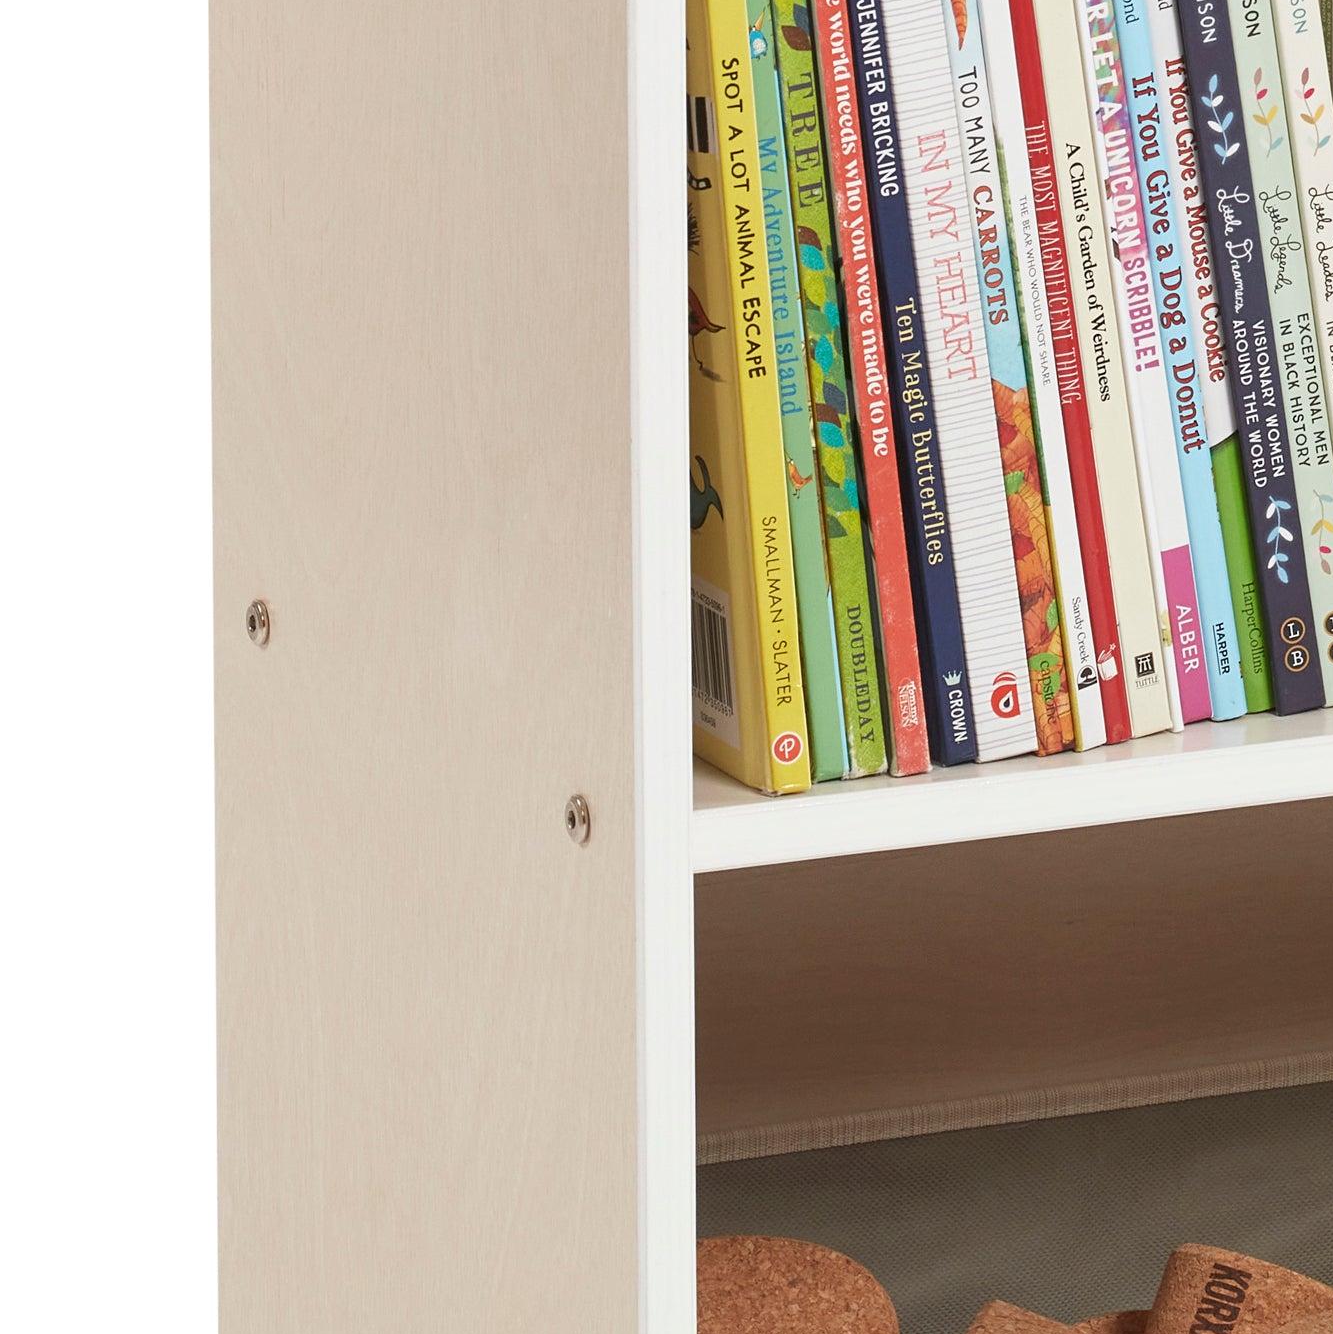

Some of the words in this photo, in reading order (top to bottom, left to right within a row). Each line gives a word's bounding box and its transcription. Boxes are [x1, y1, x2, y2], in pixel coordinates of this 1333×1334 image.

[829, 11, 851, 81] world
[857, 0, 887, 95] JENNIFER
[1089, 32, 1119, 87] LET
[1165, 57, 1186, 77] If
[722, 57, 743, 113] SPOT
[958, 66, 979, 109] TOO
[1100, 101, 1122, 121] A
[1132, 72, 1155, 99] If
[1168, 81, 1191, 126] You
[728, 126, 743, 141] A
[787, 71, 824, 209] TREE
[836, 86, 857, 155] needs
[870, 101, 899, 196] BRICKING
[964, 116, 991, 174] MANY
[1025, 121, 1048, 155] THE
[1137, 103, 1160, 161] You
[729, 150, 750, 192] LOT
[758, 136, 777, 173] My
[917, 129, 950, 173] IN
[1065, 142, 1081, 159] A
[1176, 128, 1198, 181] Give
[845, 159, 862, 219] who
[924, 180, 959, 241] MY
[1019, 195, 1029, 216] THE
[1031, 164, 1054, 211] MOST
[1105, 129, 1141, 249] UNICORN
[1146, 170, 1171, 235] Give
[1184, 186, 1199, 201] a
[1216, 185, 1250, 236] Little
[763, 187, 790, 321] Adventure
[843, 216, 867, 261] you
[973, 185, 1010, 326] CARROTS
[1022, 219, 1032, 247] BEAR
[1077, 225, 1096, 291] Garden
[1156, 244, 1174, 262] a
[1186, 202, 1211, 280] Mouse
[1026, 249, 1037, 277] WHO
[1038, 220, 1074, 340] MAGNIFICENT
[1226, 239, 1253, 314] Dreamers
[855, 269, 873, 325] were
[895, 297, 917, 342] Ten
[933, 251, 978, 381] HEART
[1031, 280, 1043, 320] WOULD
[1087, 294, 1103, 312] of
[1124, 257, 1160, 372] SCRIBBLE!
[1159, 266, 1187, 330] Dog
[1197, 285, 1213, 300] a
[743, 297, 766, 378] ESCAPE
[862, 329, 882, 397] made
[1036, 323, 1046, 348] NOT
[1090, 314, 1111, 403] Weirdness
[1169, 337, 1187, 356] a
[1200, 302, 1229, 383] Cookie
[1233, 320, 1252, 386] AROUND
[775, 331, 803, 417] Island
[901, 350, 928, 424] Magic
[1039, 352, 1050, 386] SHARE
[1055, 347, 1082, 405] THING
[868, 401, 885, 424] to
[1172, 359, 1204, 454] Donut
[1243, 392, 1258, 426] THE
[1252, 319, 1276, 408] VISIONARY
[1265, 414, 1286, 478] WOMEN
[871, 429, 889, 458] be
[1249, 429, 1267, 488] WORLD
[911, 428, 945, 566] Butterflies
[762, 516, 784, 624] SMALLMAN
[773, 640, 792, 706] SLATER
[1072, 597, 1085, 630] Sandy
[1242, 581, 1263, 674] HarperCollins
[1077, 632, 1089, 664] Creek
[1175, 605, 1199, 674] ALBER
[1215, 623, 1230, 675] HARPER
[847, 604, 875, 742] DOUBLEDAY
[1039, 660, 1057, 724] capstone
[1135, 676, 1160, 688] TUTTLE
[948, 690, 968, 742] CROWN
